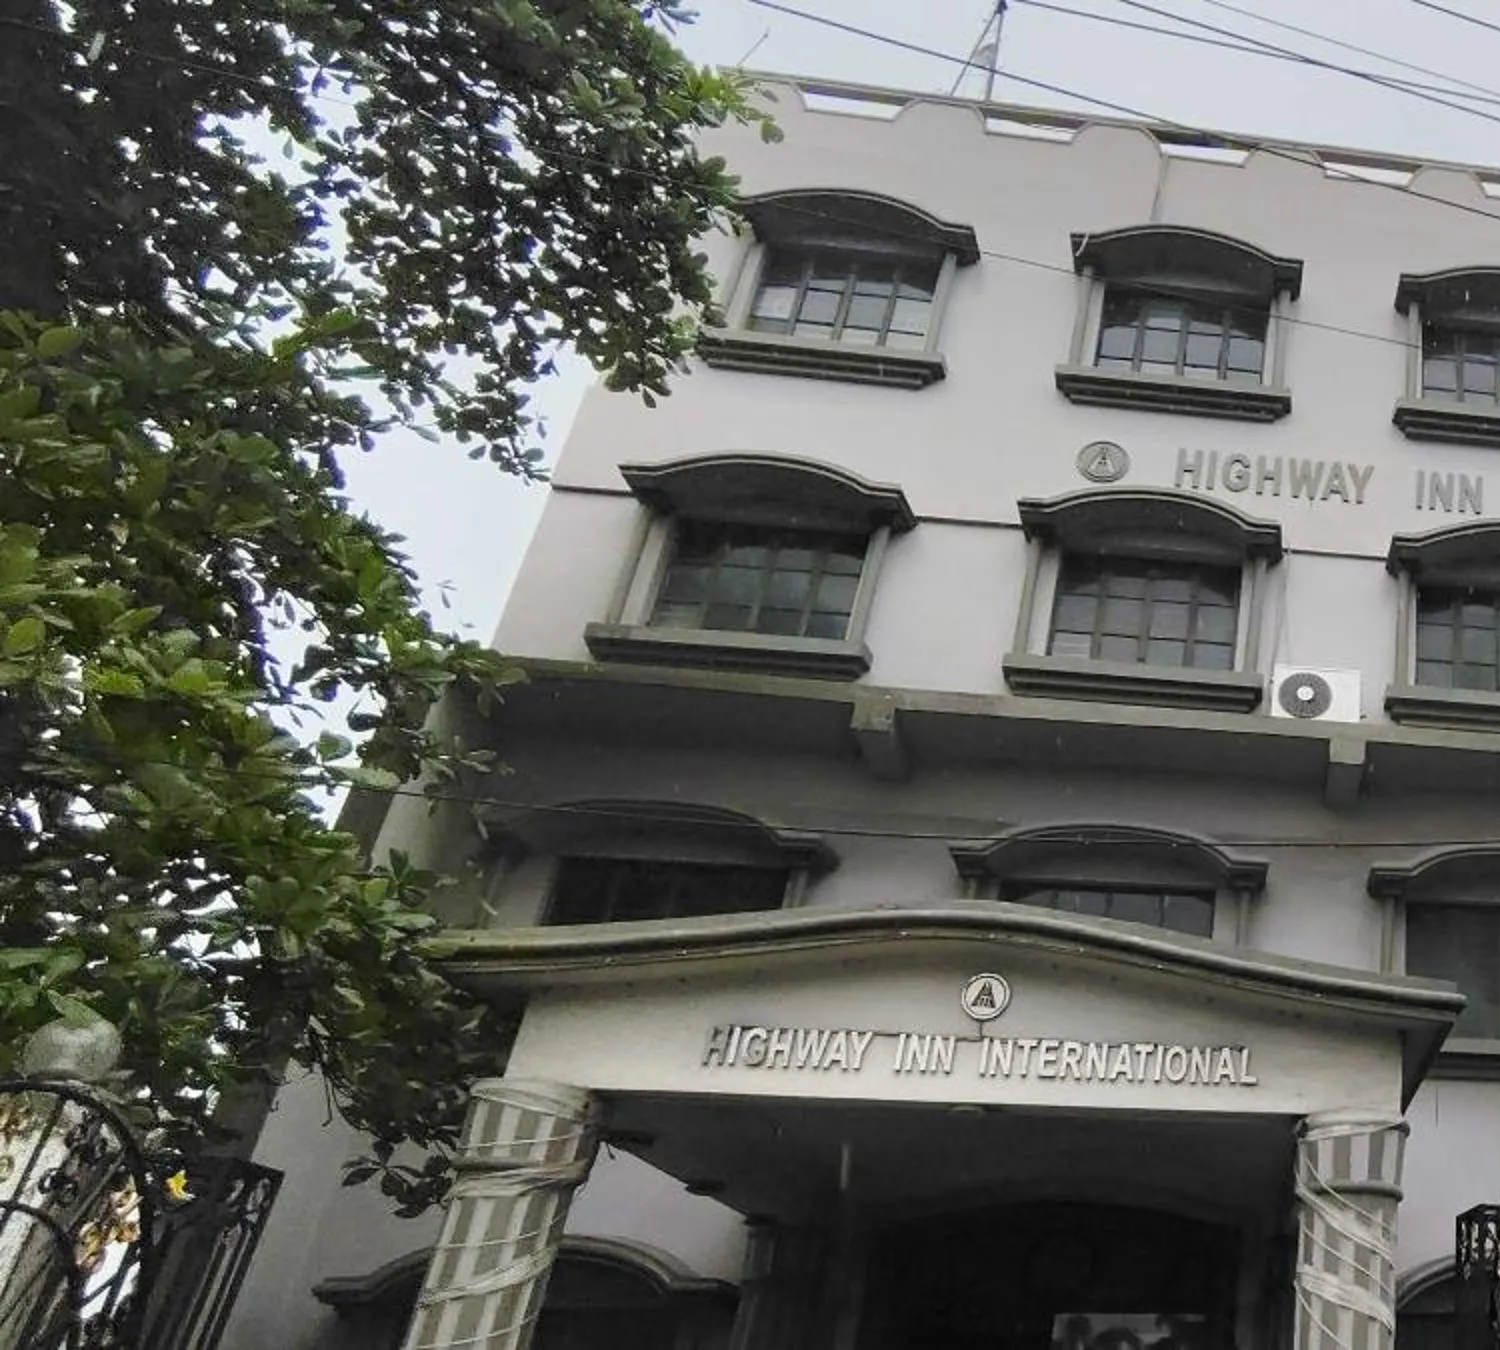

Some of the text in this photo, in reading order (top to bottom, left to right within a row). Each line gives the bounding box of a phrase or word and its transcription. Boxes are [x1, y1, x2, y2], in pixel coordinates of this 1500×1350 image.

[1173, 447, 1375, 504] HIGHWAY
[1415, 469, 1484, 515] INN
[702, 1025, 1258, 1087] HIGHWAY INN INTERNATIONAL
